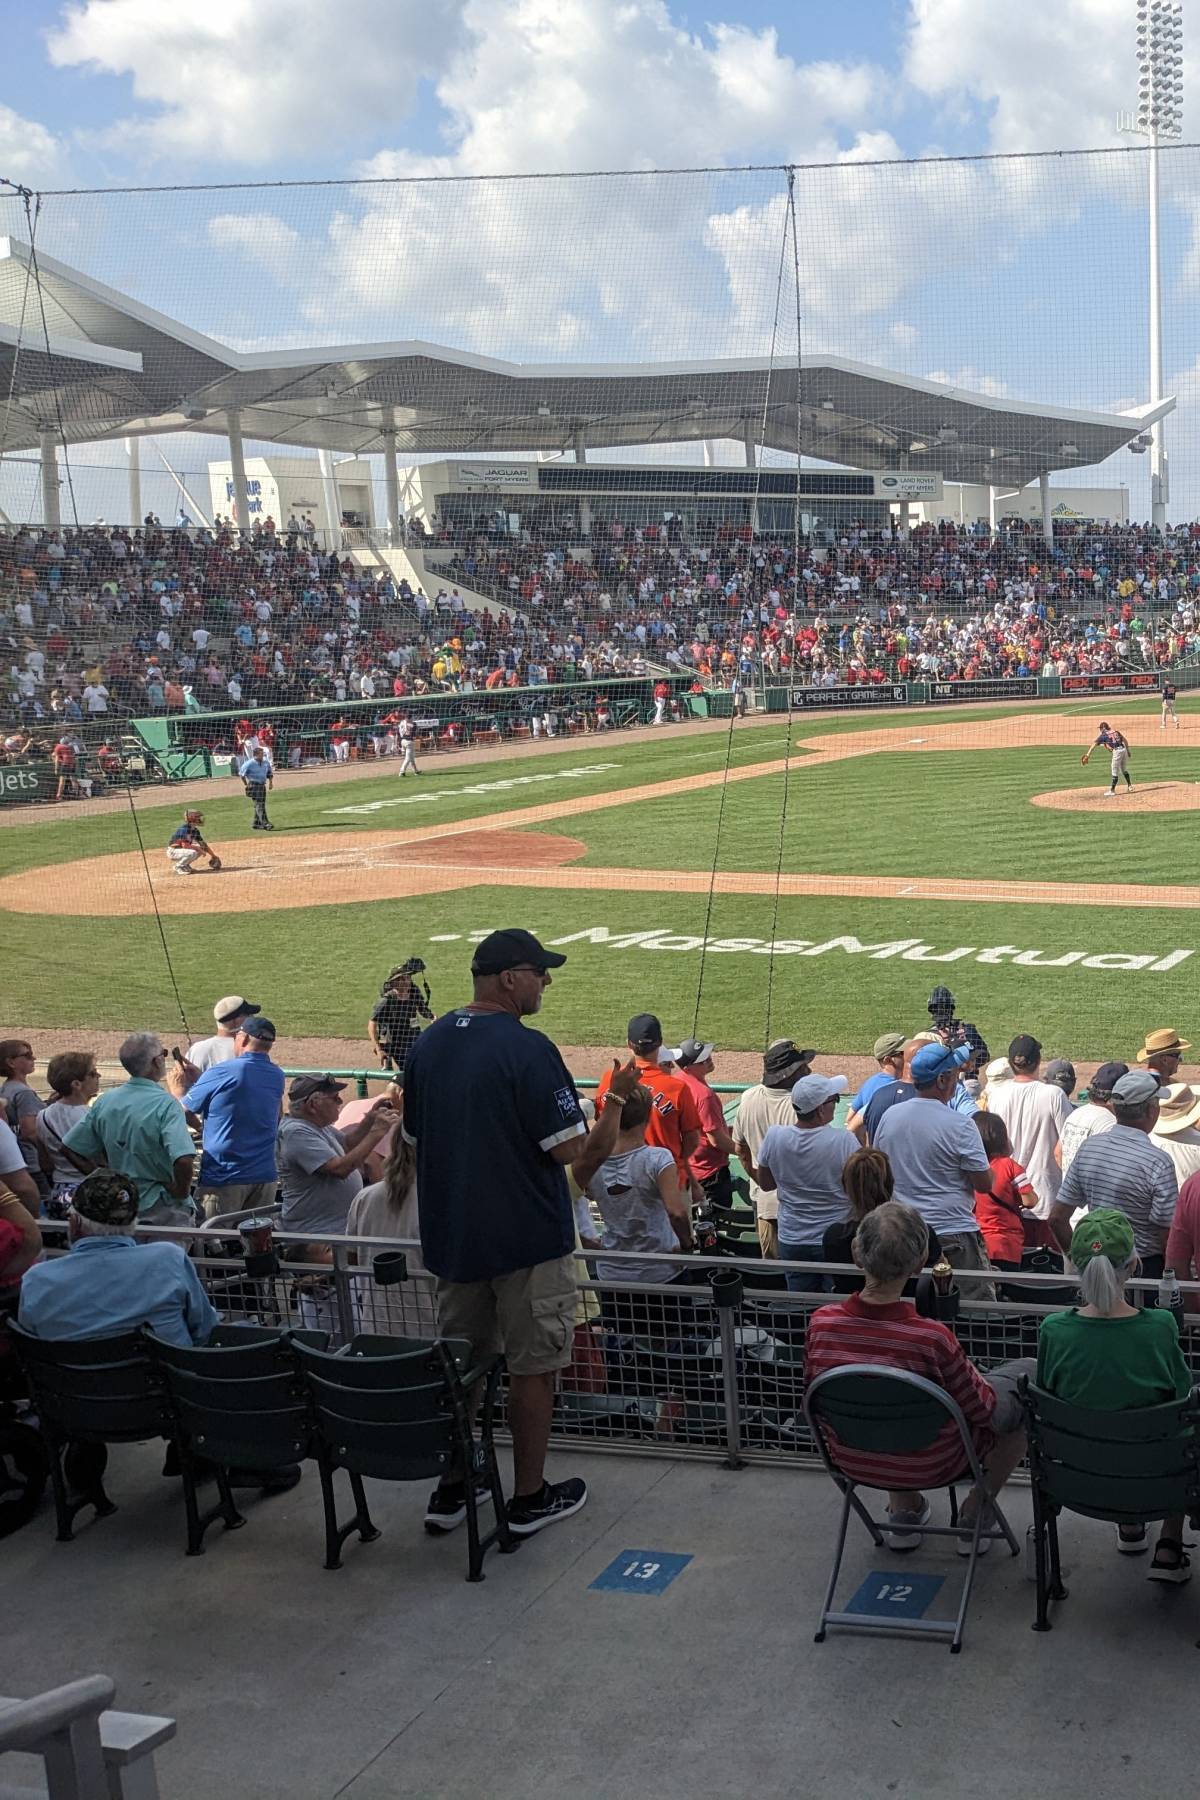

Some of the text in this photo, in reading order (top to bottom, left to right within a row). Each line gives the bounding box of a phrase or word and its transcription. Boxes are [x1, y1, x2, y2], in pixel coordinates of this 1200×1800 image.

[806, 691, 849, 701] PERFECT
[544, 927, 1196, 971] MassMutual
[623, 1561, 660, 1579] 13
[876, 1584, 913, 1602] 12
